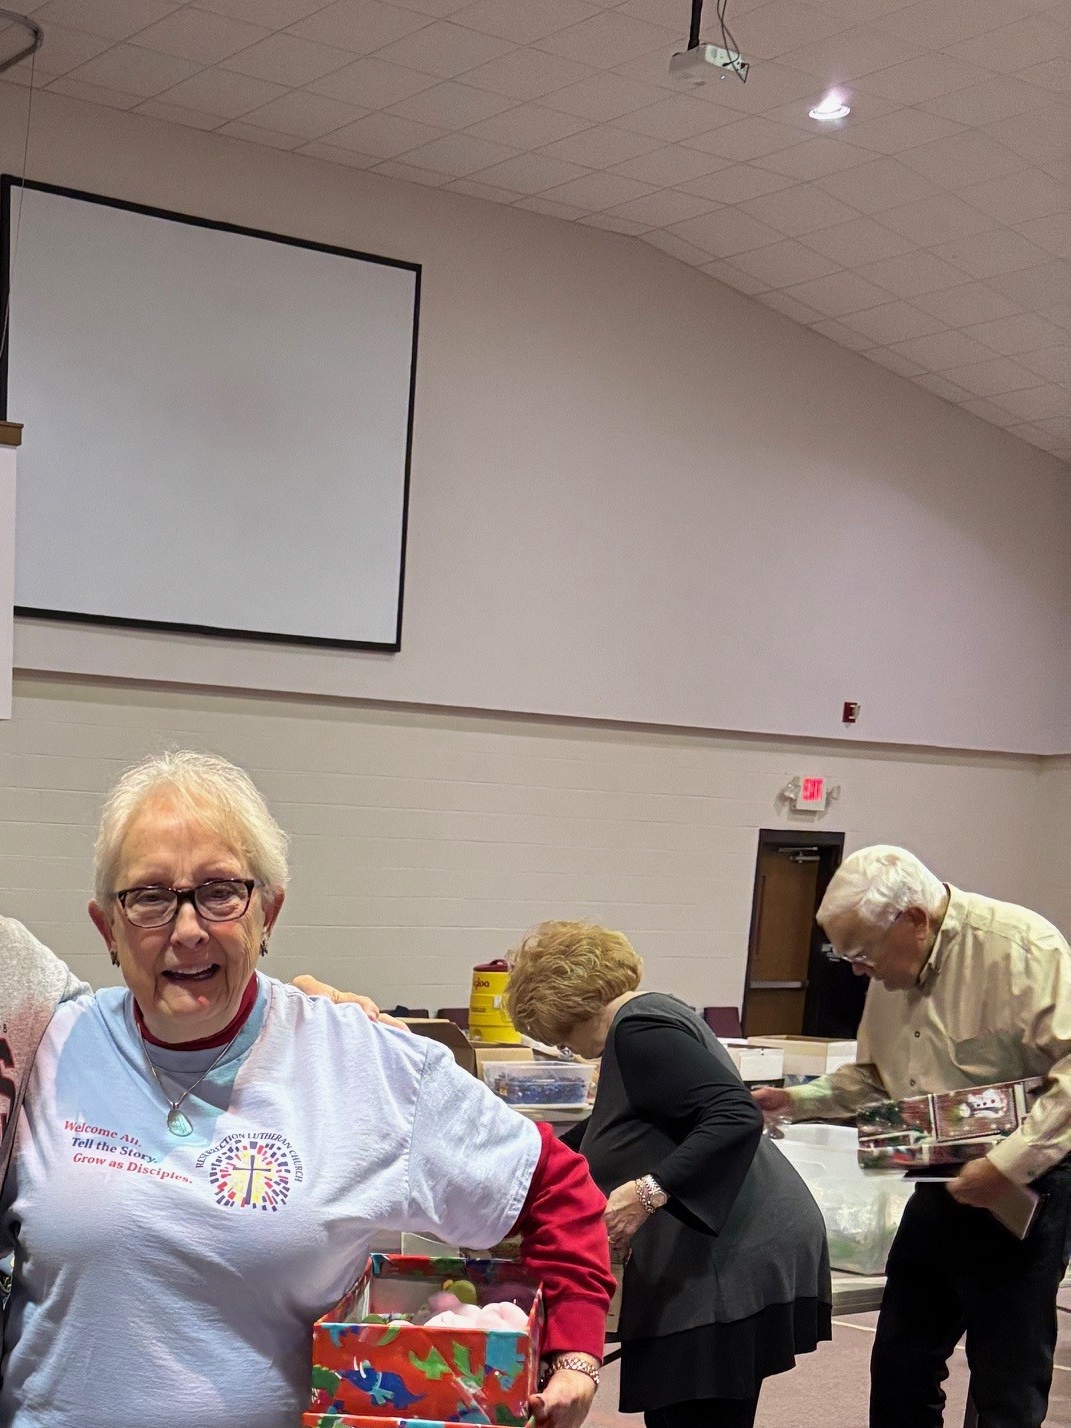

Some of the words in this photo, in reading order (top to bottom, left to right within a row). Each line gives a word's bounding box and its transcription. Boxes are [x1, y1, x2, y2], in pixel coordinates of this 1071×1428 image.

[803, 778, 823, 801] EXIT
[64, 1120, 118, 1140] Welcome
[71, 1137, 94, 1149] Tell
[95, 1140, 117, 1154] the
[120, 1145, 158, 1164] Story.
[247, 1132, 291, 1149] LUTHERAN
[289, 1148, 304, 1183] CHURCH
[73, 1152, 107, 1166] Grow
[108, 1160, 125, 1171] as
[126, 1161, 193, 1184] Disciples.
